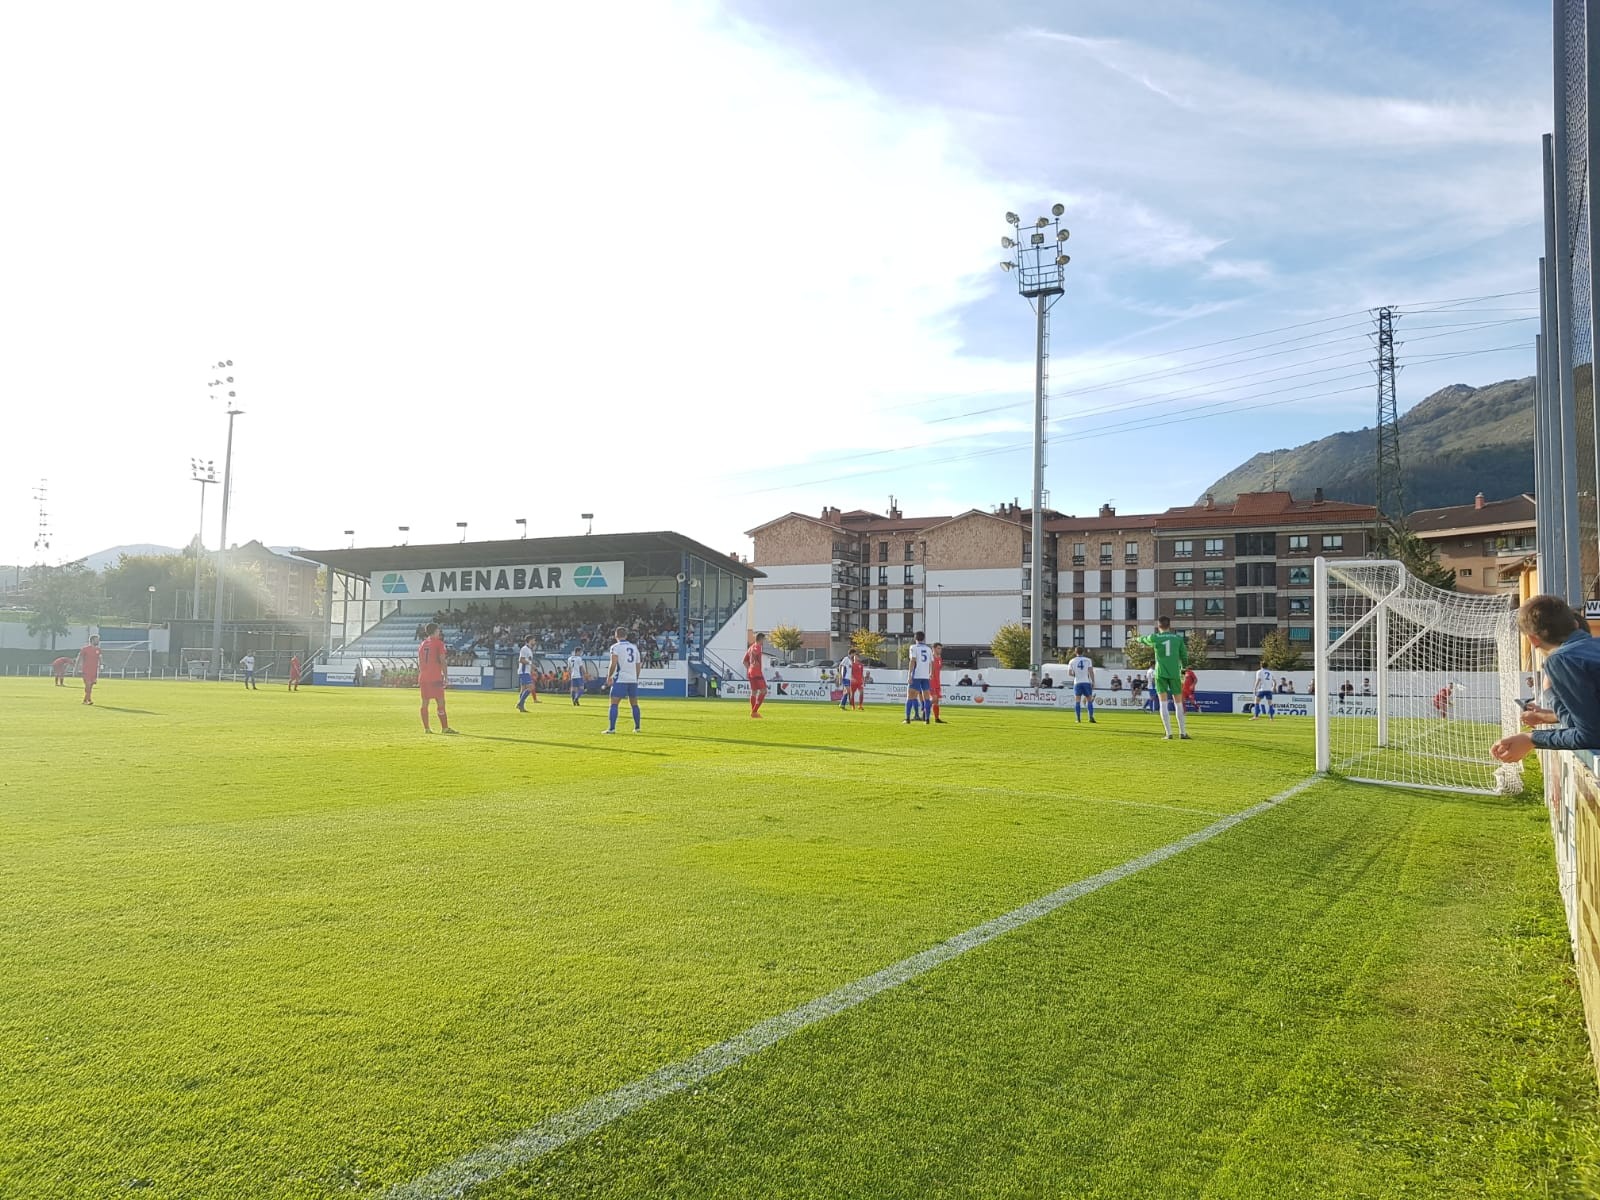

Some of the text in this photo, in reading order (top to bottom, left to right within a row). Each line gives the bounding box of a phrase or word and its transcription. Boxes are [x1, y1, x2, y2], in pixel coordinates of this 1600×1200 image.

[420, 567, 562, 593] AMENABAR
[626, 647, 634, 663] 3
[1162, 640, 1170, 657] 1
[921, 650, 928, 662] 5
[1077, 660, 1084, 670] 4
[1264, 671, 1271, 681] 2
